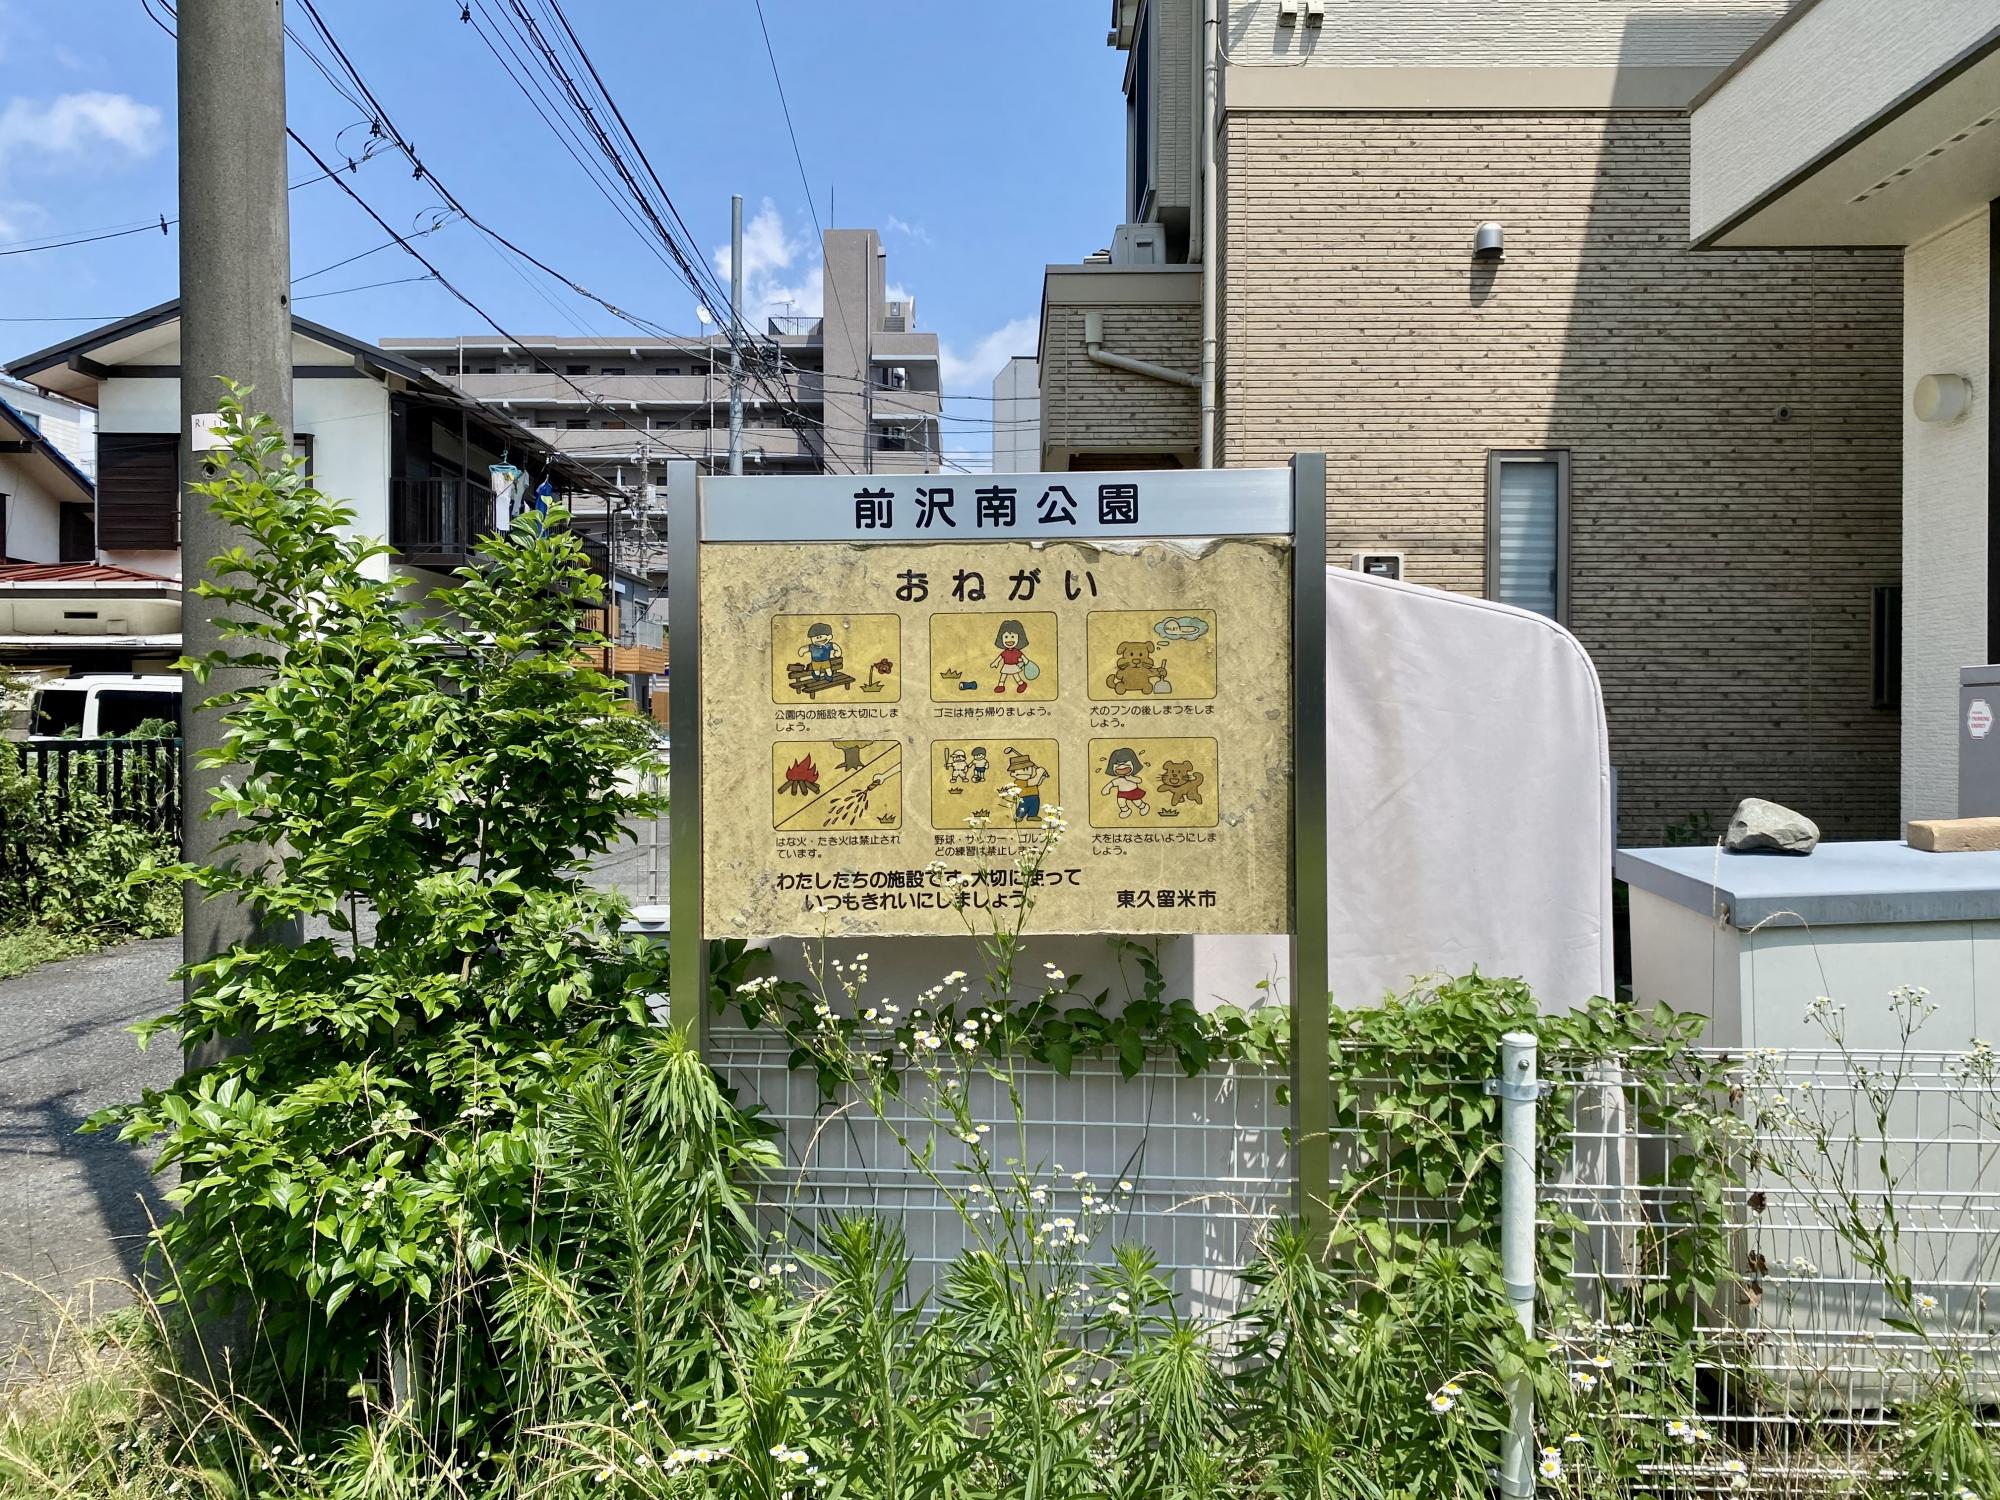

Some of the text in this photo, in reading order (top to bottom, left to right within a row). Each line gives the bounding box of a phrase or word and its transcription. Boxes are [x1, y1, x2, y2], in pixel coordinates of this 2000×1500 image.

[853, 483, 1139, 529] 前沢南公園
[895, 567, 1098, 602] おねがい
[774, 707, 899, 721] 公園内の施設を大切にしま
[933, 706, 1052, 718] ゴミは持ち帰りましょう。
[1089, 704, 1215, 716] 犬のフンの後しまつをしま
[775, 721, 811, 732] しょう。
[1090, 717, 1125, 728] しょう。
[775, 834, 901, 848] はな火・たき火は禁止され
[934, 833, 1057, 846] 野球・サッカー・ゴルフ
[1092, 832, 1217, 844] 犬をはなさないようにしま
[777, 848, 822, 859] ています。
[1092, 845, 1128, 856] しょう。
[1116, 889, 1217, 909] 東久留米市
